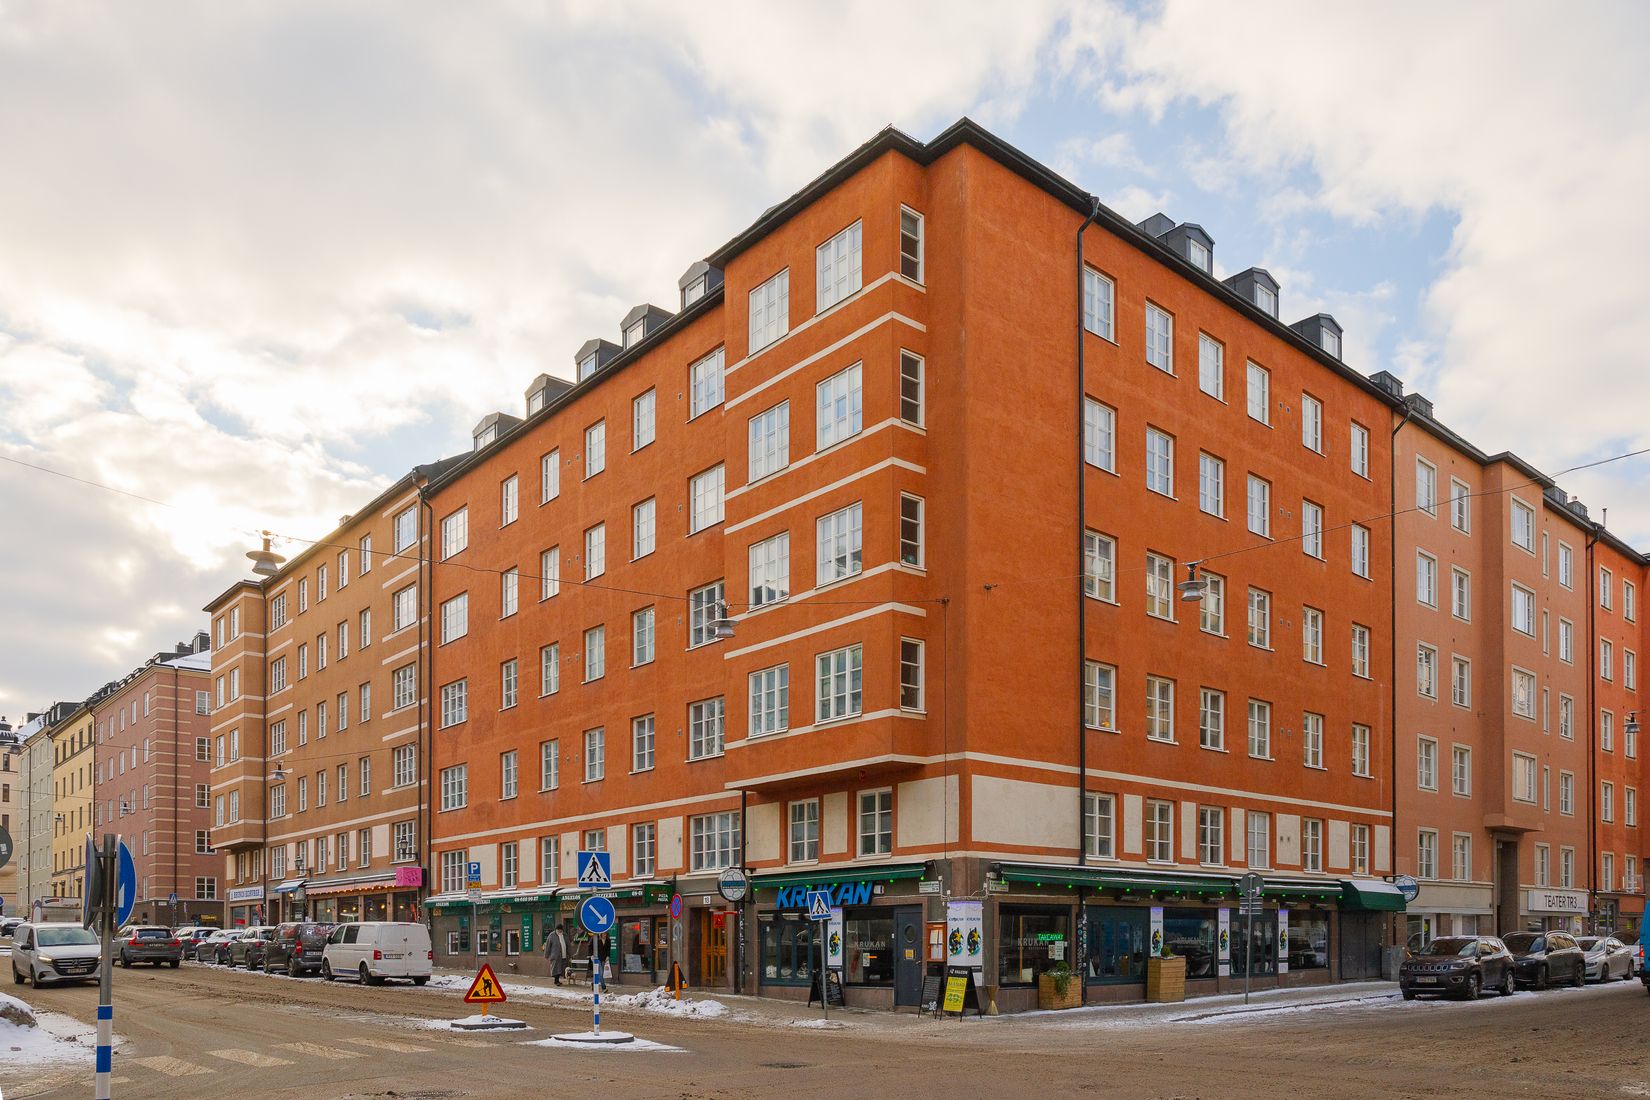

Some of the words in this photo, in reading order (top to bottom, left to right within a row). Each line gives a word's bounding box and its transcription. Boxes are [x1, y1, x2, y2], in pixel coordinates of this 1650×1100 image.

[471, 864, 478, 873] P
[1544, 895, 1566, 908] TEATER
[1567, 896, 1577, 908] TR3
[1018, 938, 1049, 946] KRUKAN
